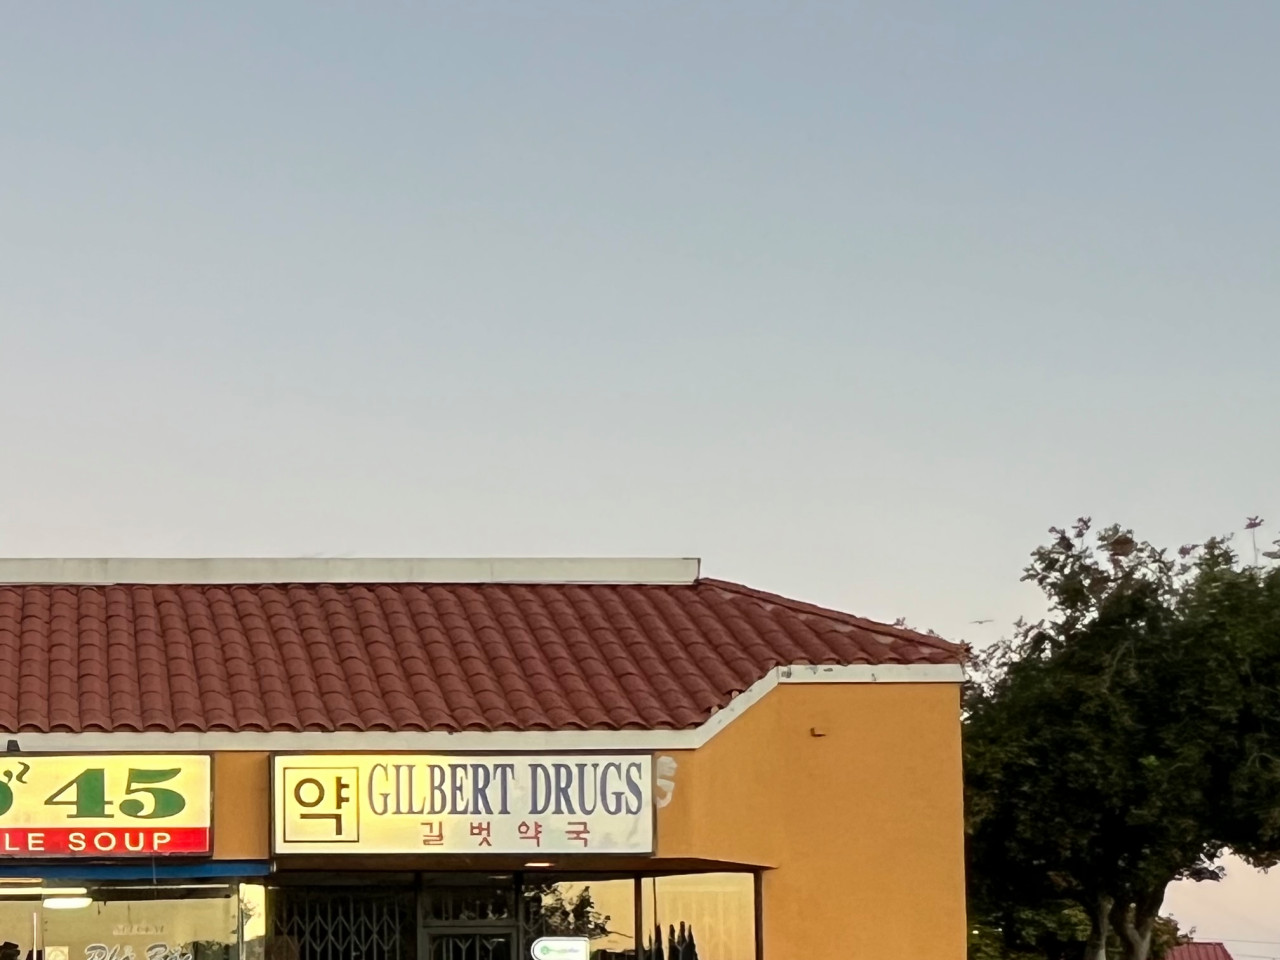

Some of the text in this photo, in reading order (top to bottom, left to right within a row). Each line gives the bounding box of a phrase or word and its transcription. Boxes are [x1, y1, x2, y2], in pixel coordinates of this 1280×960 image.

[44, 768, 186, 819] 45
[294, 777, 350, 836] 약
[368, 762, 643, 815] GILBERT DRUGS
[68, 832, 172, 851] SOUP
